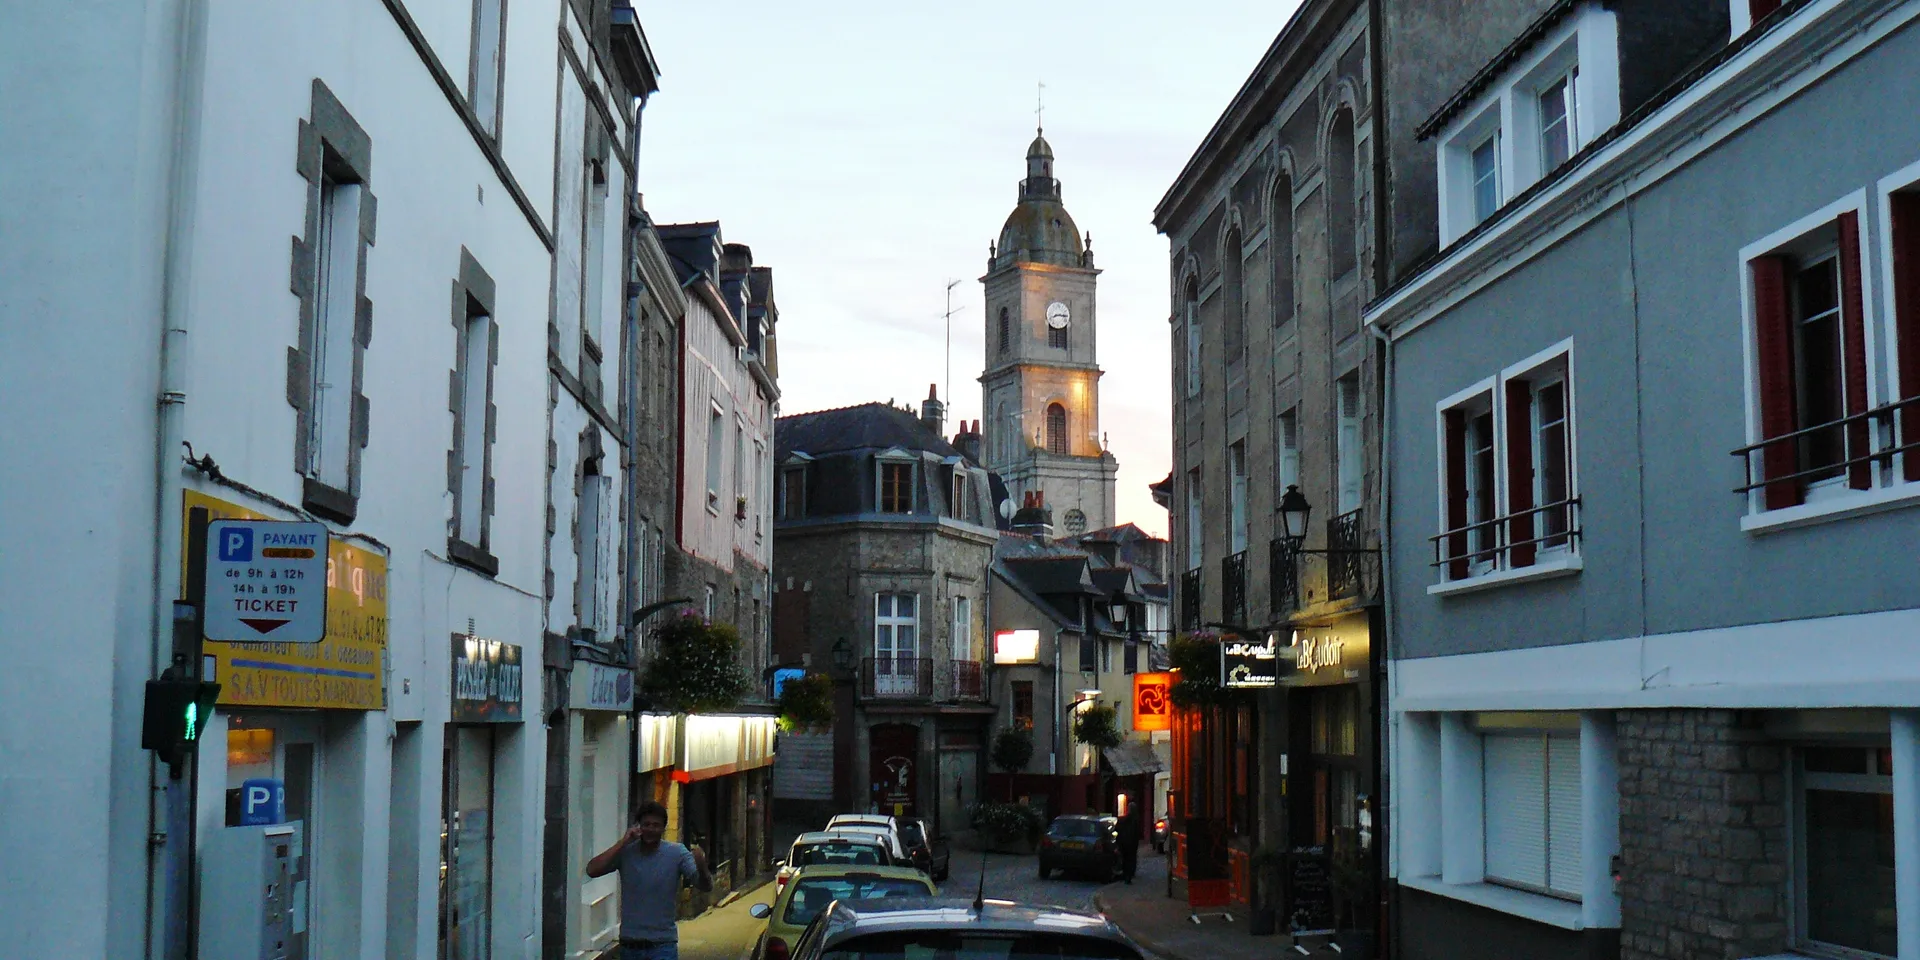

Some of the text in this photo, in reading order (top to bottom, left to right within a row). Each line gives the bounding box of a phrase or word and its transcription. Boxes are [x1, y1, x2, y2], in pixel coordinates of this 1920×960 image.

[228, 533, 245, 557] P
[263, 533, 317, 546] PAYANT
[226, 568, 304, 579] de 9h à 12h
[233, 584, 254, 594] 14h
[275, 584, 295, 595] 19h
[235, 599, 298, 613] TICKET
[247, 786, 271, 814] P
